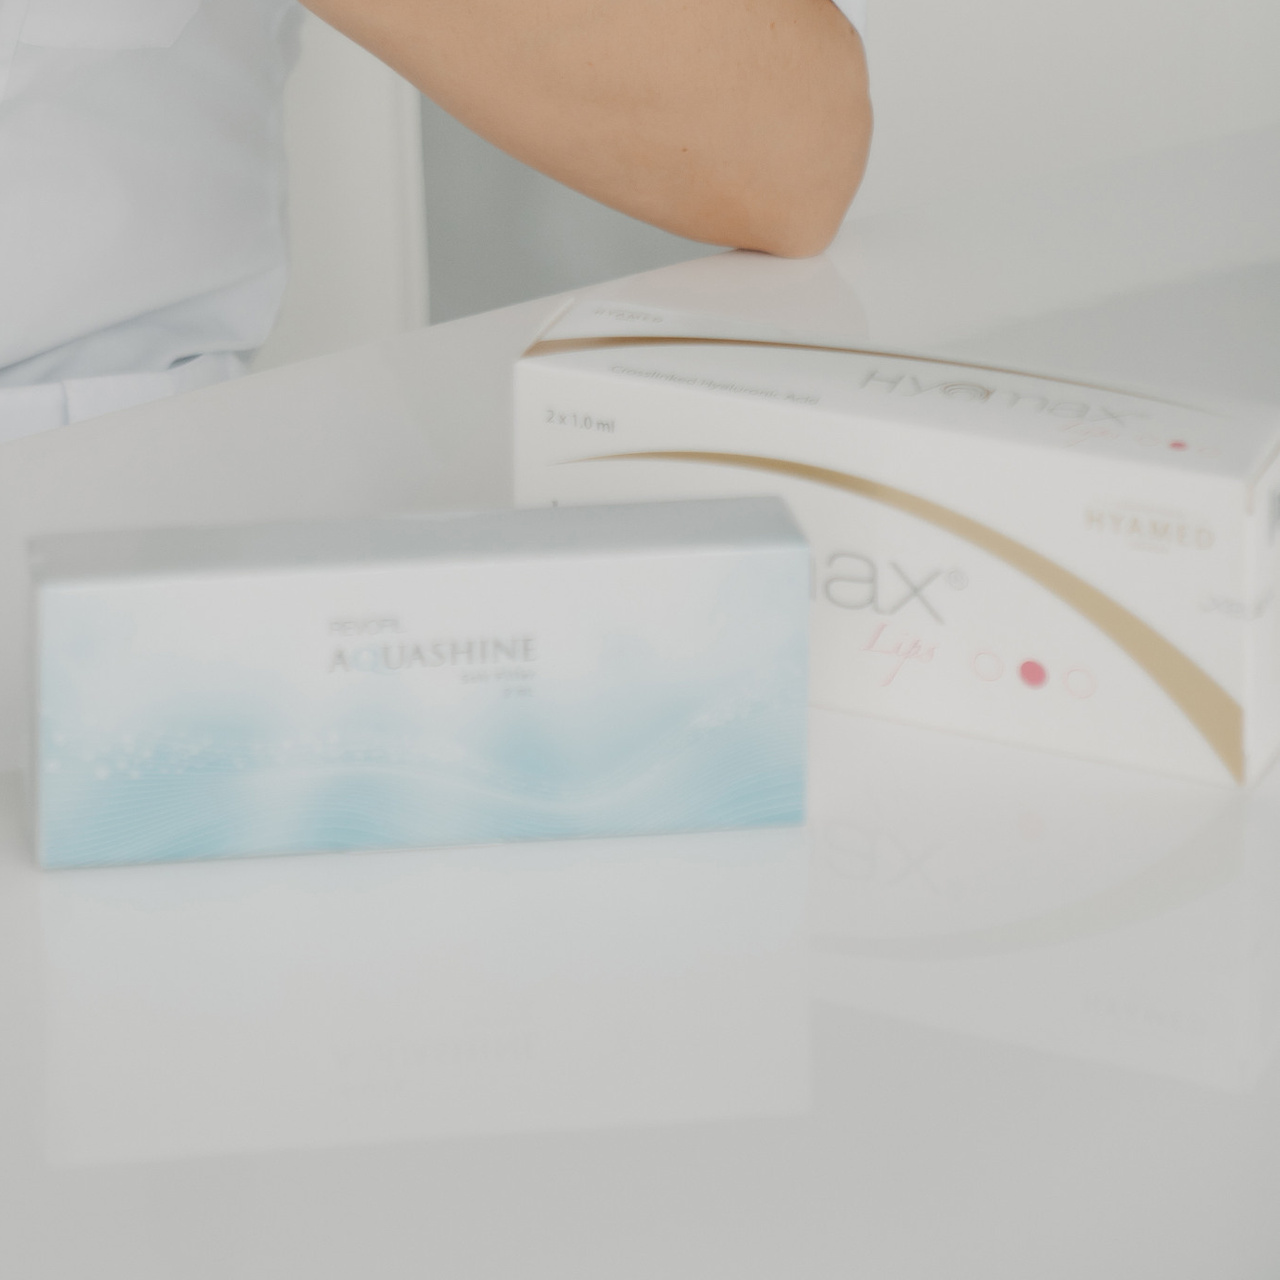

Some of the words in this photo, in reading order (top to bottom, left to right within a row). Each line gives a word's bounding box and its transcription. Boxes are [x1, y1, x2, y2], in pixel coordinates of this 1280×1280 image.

[545, 407, 555, 424] 2
[558, 413, 567, 425] x
[572, 411, 593, 431] 1.0
[596, 419, 616, 434] ml
[1081, 507, 1217, 551] HYAMED
[327, 636, 538, 676] AQUASHINE
[860, 621, 937, 688] Lips
